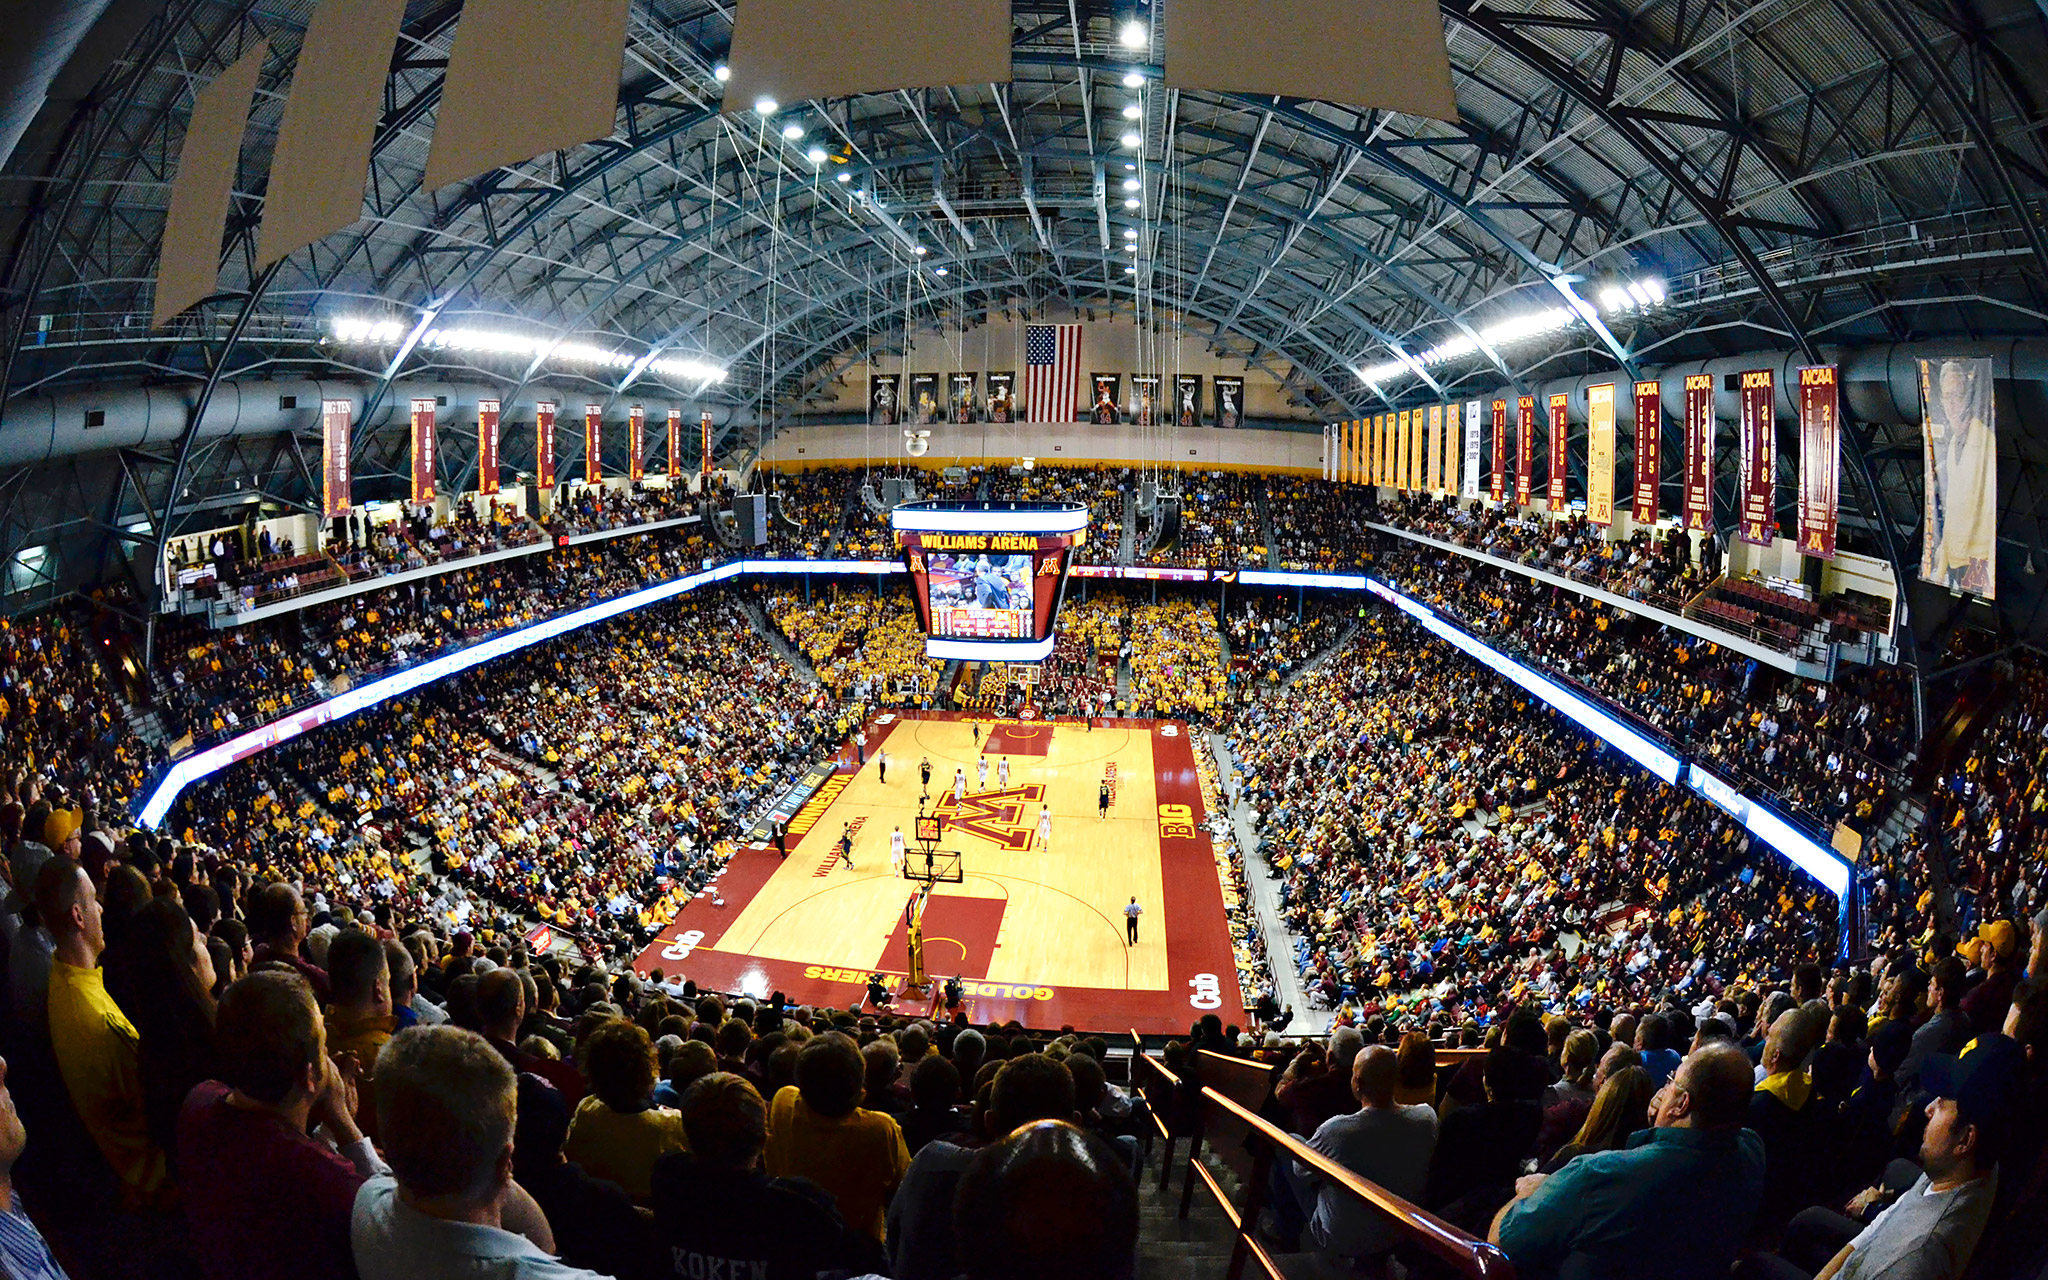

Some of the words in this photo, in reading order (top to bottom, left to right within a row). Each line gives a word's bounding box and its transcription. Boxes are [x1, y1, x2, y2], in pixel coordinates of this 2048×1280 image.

[1686, 376, 1711, 390] NCAA
[1743, 372, 1771, 388] NCAA
[1802, 369, 1834, 385] NCAA
[1636, 383, 1659, 396] NCAA
[323, 401, 336, 413] BIG
[337, 401, 351, 413] TEN
[411, 401, 422, 412] BIG
[423, 401, 435, 412] TEN
[478, 402, 488, 412] BIG
[489, 402, 500, 412] TEN
[537, 403, 545, 413] BIG
[546, 403, 555, 413] TEN
[1492, 400, 1506, 410] NCAA
[1518, 397, 1534, 408] NCAA
[1551, 396, 1567, 407] NCAA
[339, 430, 347, 482] 1906
[920, 535, 987, 550] WILLIAMS
[990, 536, 1038, 550] ARENA
[910, 555, 926, 574] M
[1037, 557, 1060, 576] M
[961, 717, 1019, 725] GOLDEN
[788, 774, 854, 834] MINNESOTA
[661, 929, 705, 961] Cub
[1189, 973, 1222, 1010] Cub
